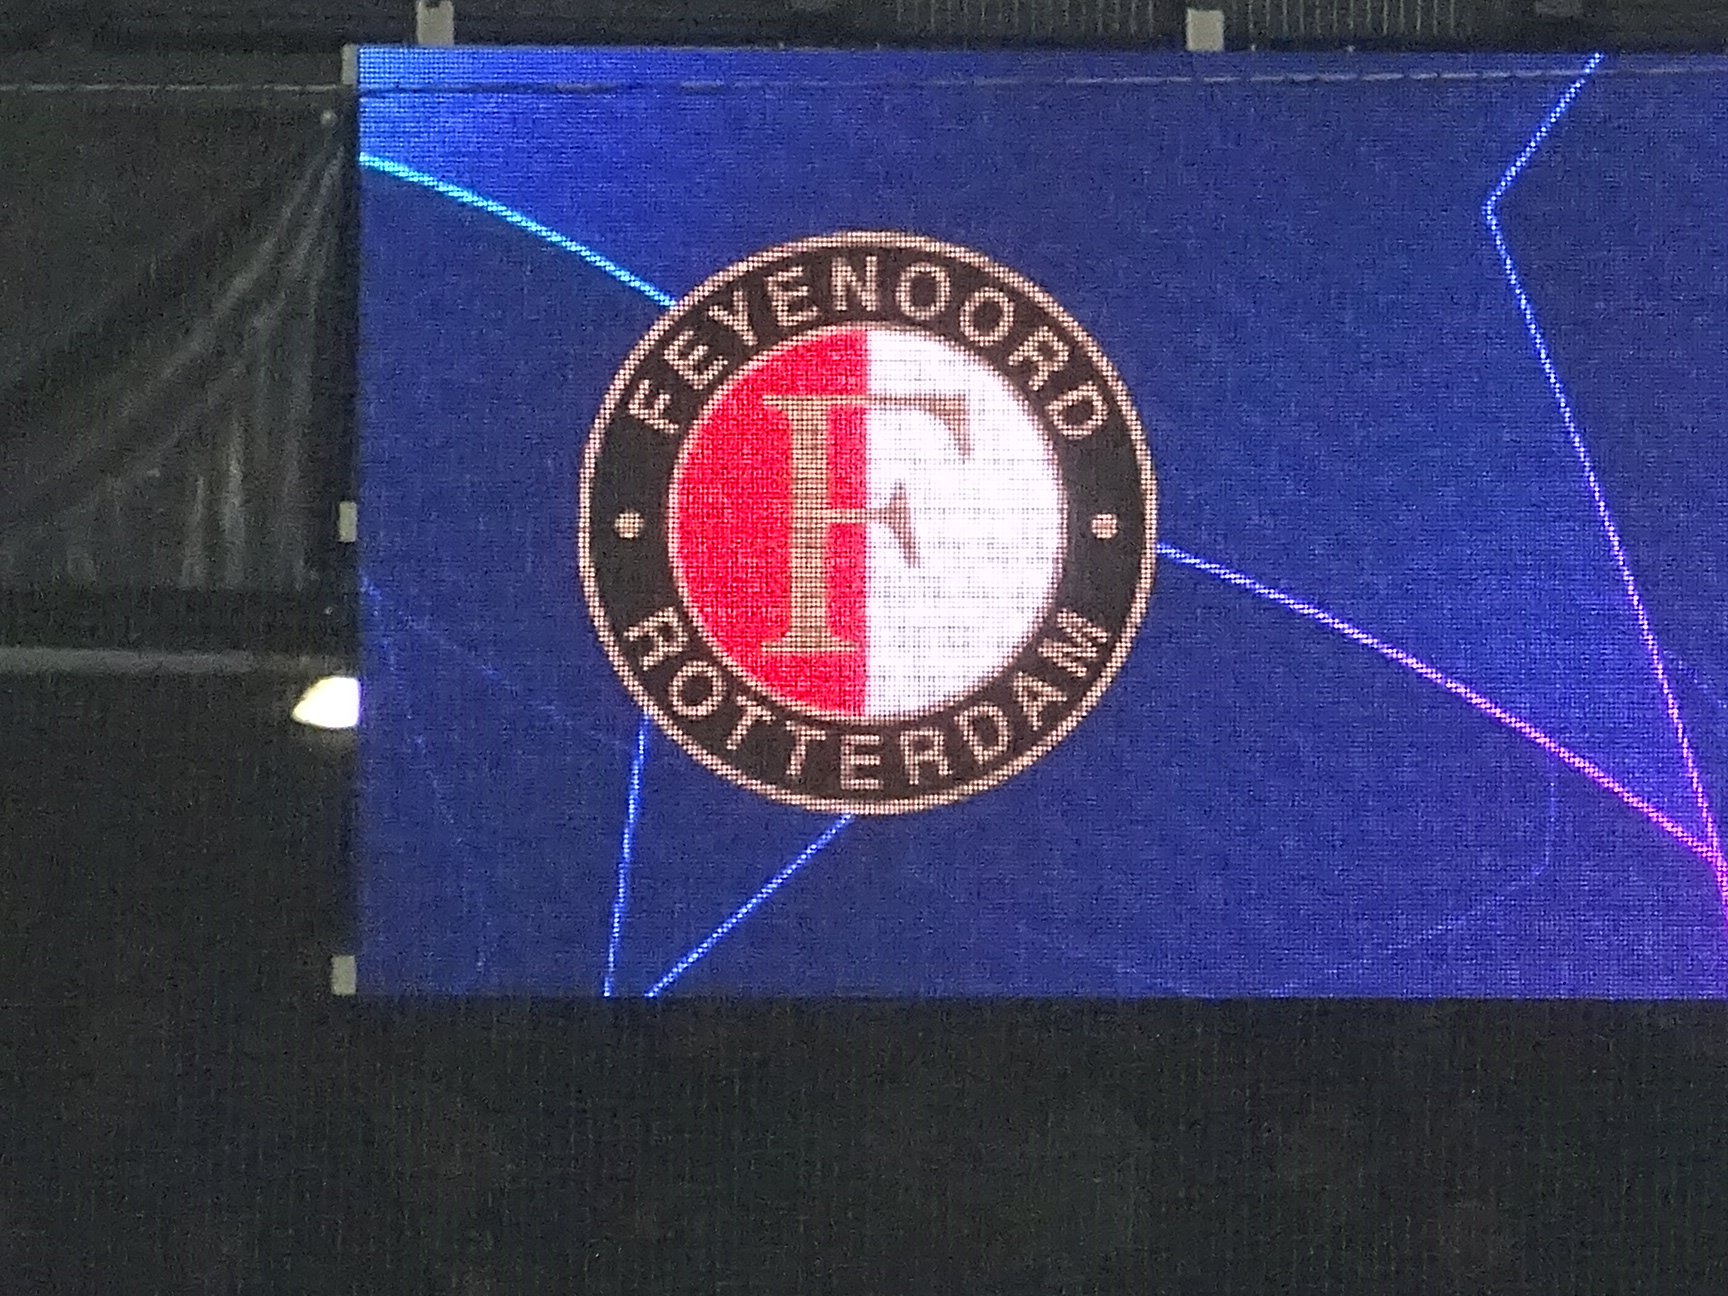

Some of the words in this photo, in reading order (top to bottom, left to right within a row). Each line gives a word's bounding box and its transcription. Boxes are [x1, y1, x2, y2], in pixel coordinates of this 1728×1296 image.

[627, 254, 1109, 441] FEYENOORD
[760, 393, 970, 654] F
[624, 605, 1107, 791] ROTTERDAM
